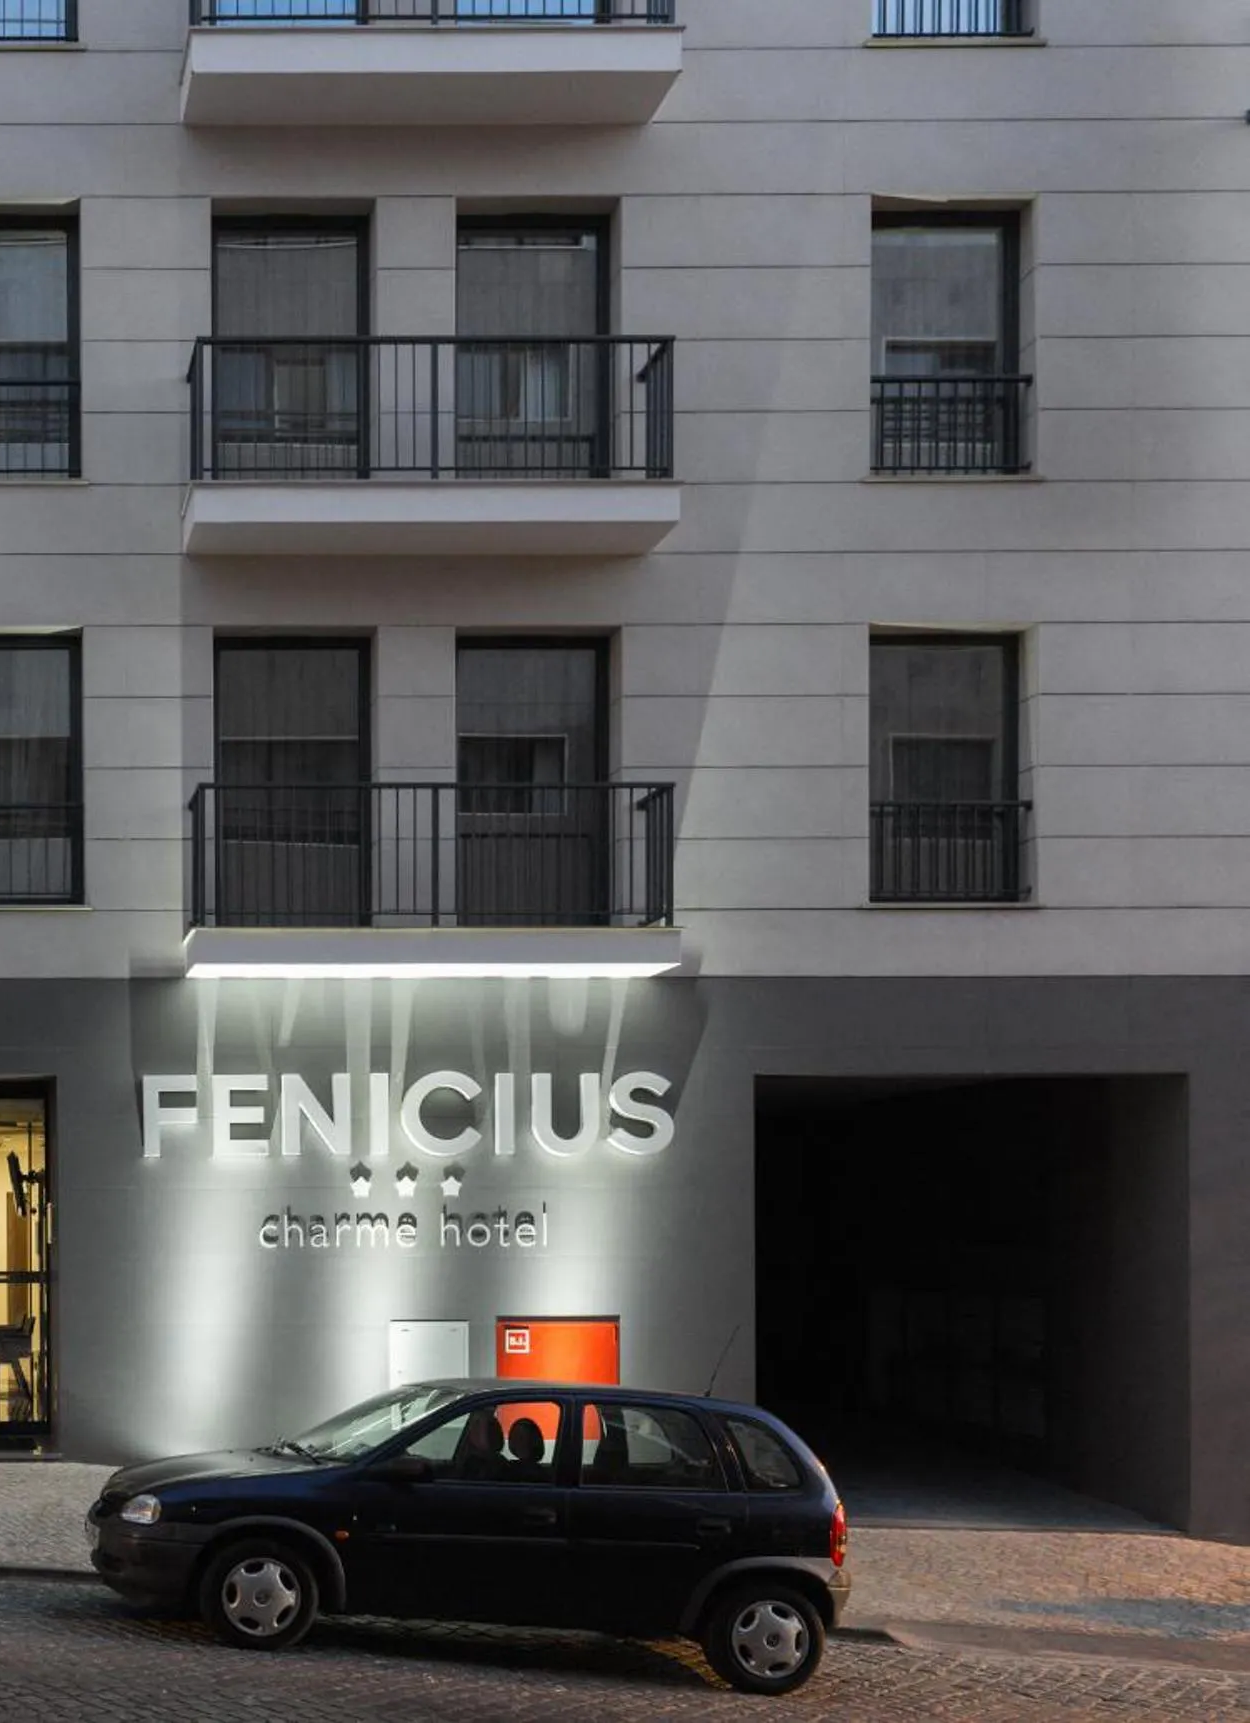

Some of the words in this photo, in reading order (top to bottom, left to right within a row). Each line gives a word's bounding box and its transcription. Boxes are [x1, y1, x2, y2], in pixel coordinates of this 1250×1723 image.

[143, 1070, 676, 1158] FENICIUS
[258, 1212, 419, 1249] charme
[440, 1211, 549, 1248] hotel
